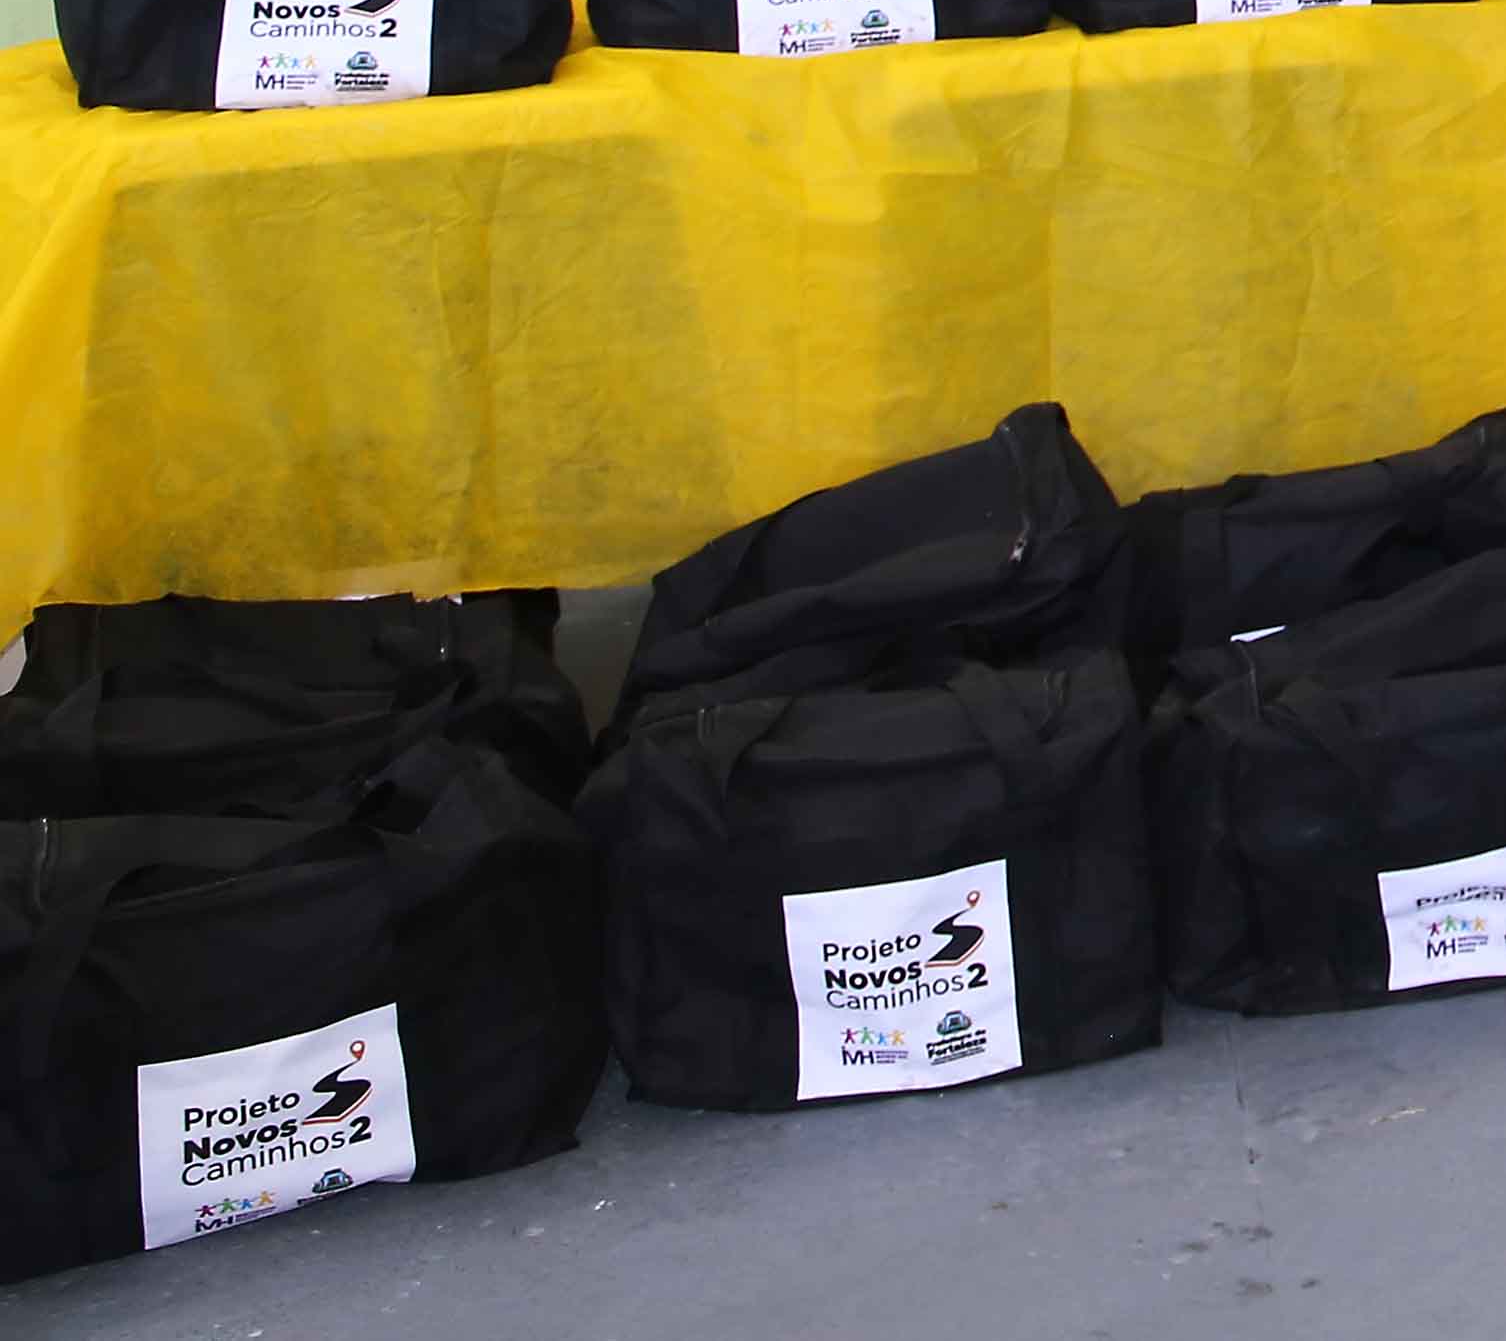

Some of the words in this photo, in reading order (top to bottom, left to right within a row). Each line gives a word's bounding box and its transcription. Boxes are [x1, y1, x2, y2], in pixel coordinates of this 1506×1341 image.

[253, 1, 341, 19] Novos
[250, 19, 377, 38] Caminhos
[379, 18, 397, 38] 2
[823, 933, 921, 963] Projeto
[824, 961, 922, 990] Novos
[826, 974, 964, 1010] Caminhos
[967, 962, 988, 989] 2
[183, 1092, 300, 1132] Projeto
[181, 1131, 345, 1186] Caminhos
[348, 1116, 372, 1145] 2
[183, 1118, 298, 1164] Novos
